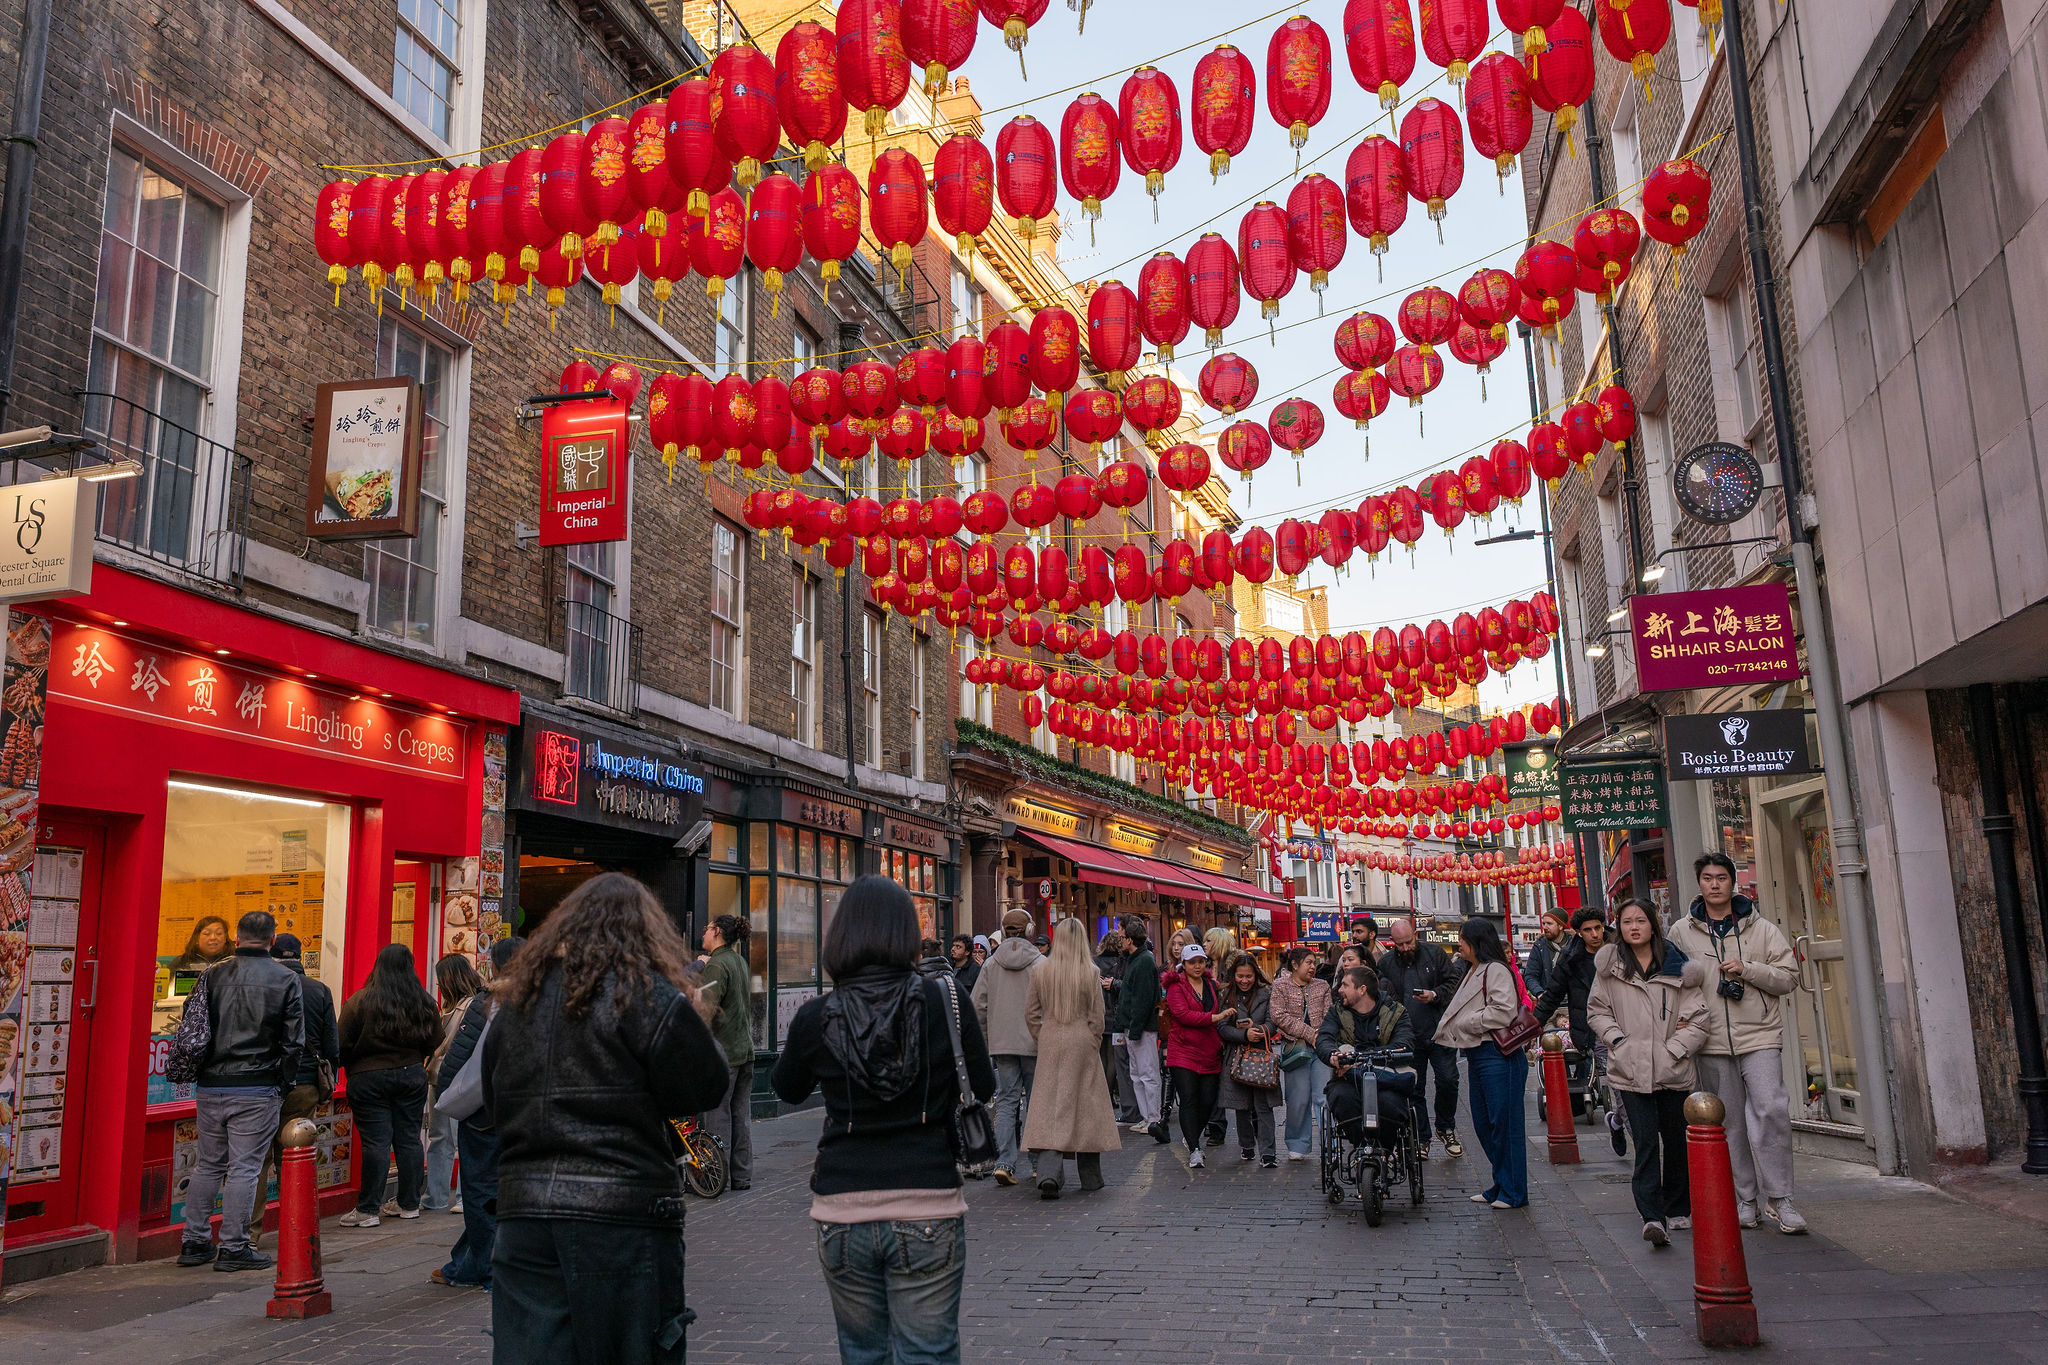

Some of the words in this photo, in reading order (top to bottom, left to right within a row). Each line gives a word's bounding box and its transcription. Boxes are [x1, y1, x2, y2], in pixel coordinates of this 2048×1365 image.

[640, 117, 660, 134] 福
[598, 132, 618, 150] 福
[1677, 447, 1710, 487] CHINATOWN
[1713, 446, 1736, 455] HAIR
[1738, 452, 1758, 476] SALON
[557, 497, 606, 514] Imperial
[563, 516, 598, 529] China
[0, 562, 29, 573] cester
[31, 556, 65, 571] Square
[0, 574, 25, 588] ental
[28, 570, 57, 585] Clinic
[1651, 644, 1676, 659] SH
[1679, 641, 1721, 657] HAIR
[1724, 636, 1785, 653] SALON
[1708, 660, 1788, 675] 020-77342146
[398, 728, 454, 764] Crepes
[1680, 750, 1728, 766] Rosie
[1731, 748, 1795, 764] Beauty
[597, 739, 659, 781] Imperial
[665, 764, 703, 794] China
[1565, 770, 1654, 786] 正宗刀削面、拉面
[1510, 785, 1541, 796] Gourmet
[1570, 785, 1655, 800] 米粉、烤串、甜品
[1006, 803, 1030, 818] AWARD
[1032, 809, 1060, 826] WINNING
[1061, 817, 1074, 829] GAY
[1574, 819, 1599, 828] Home
[1599, 818, 1625, 827] Made
[1625, 816, 1655, 826] Noodles
[1040, 885, 1050, 894] 20
